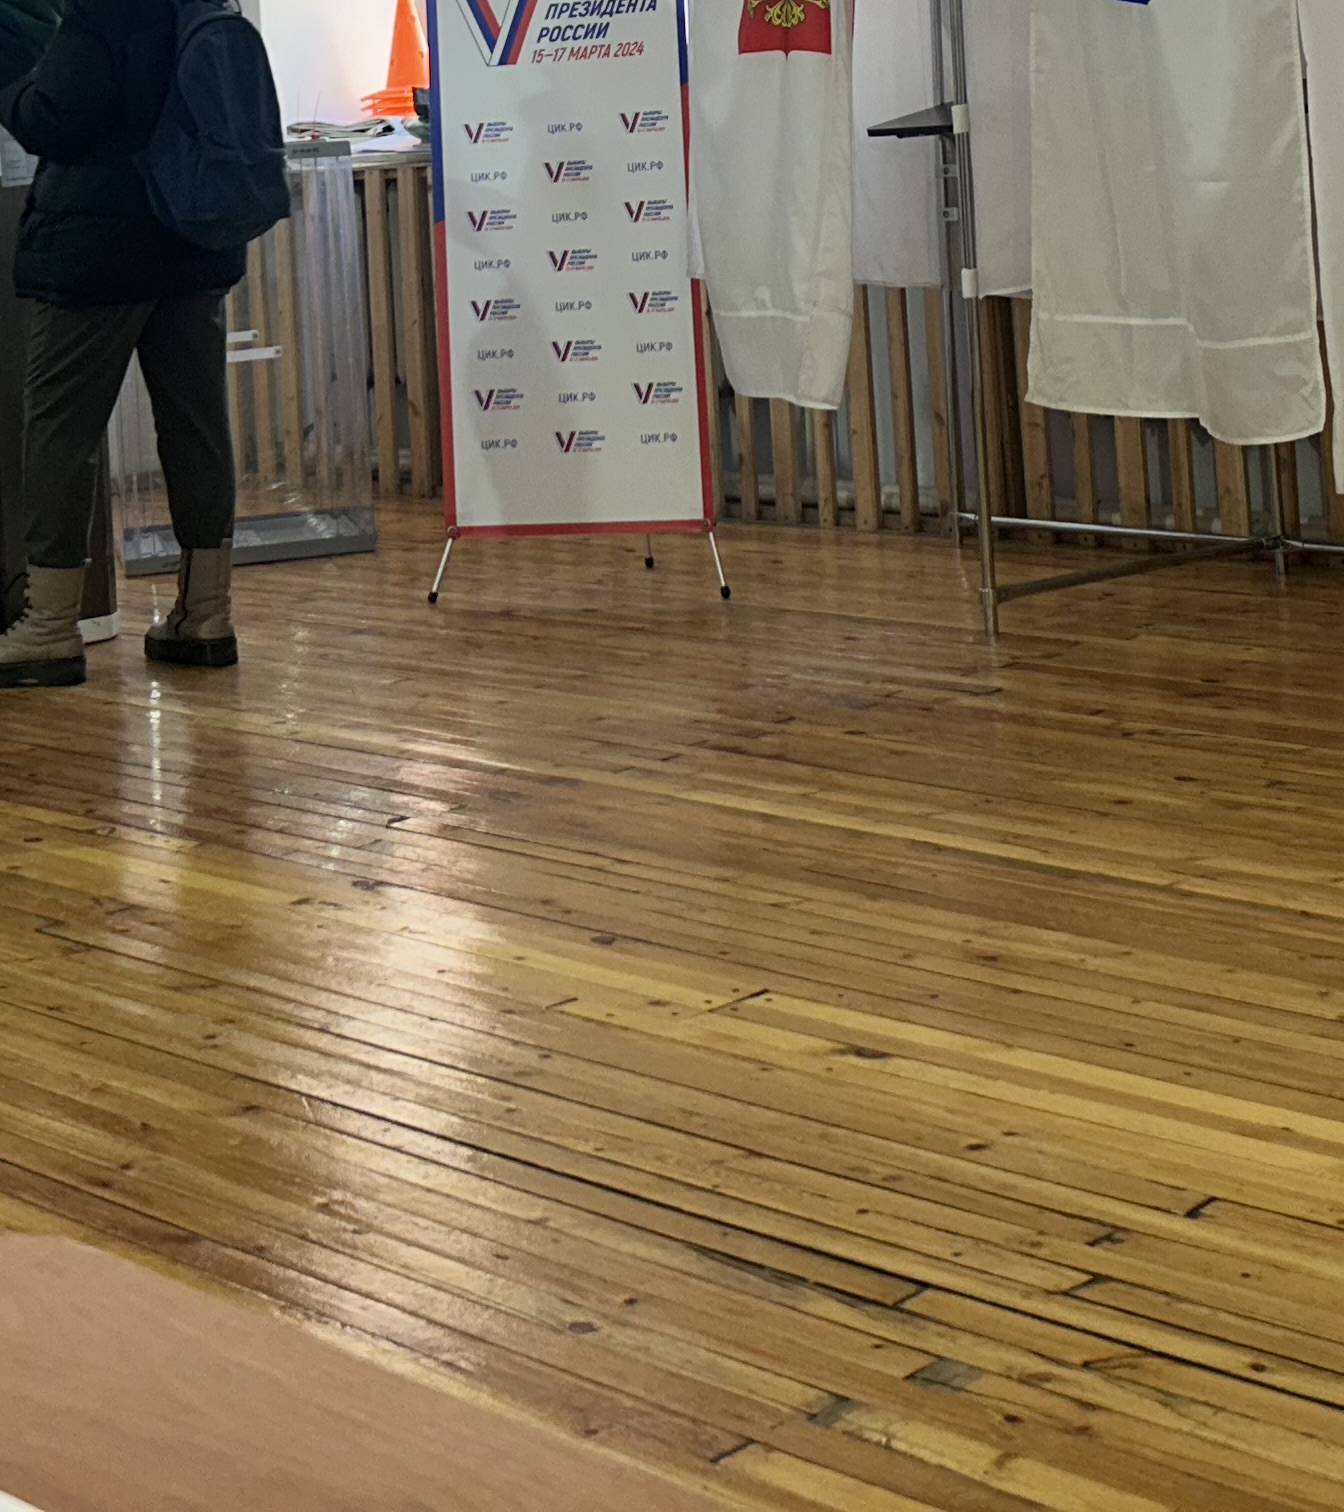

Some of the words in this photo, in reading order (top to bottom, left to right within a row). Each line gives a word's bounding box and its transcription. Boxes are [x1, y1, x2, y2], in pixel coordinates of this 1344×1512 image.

[537, 22, 610, 44] РОССИИ
[567, 44, 611, 61] МАРТА
[613, 41, 645, 58] 2024
[548, 122, 583, 134] ЦИК.РФ
[628, 161, 664, 173] ЦИК.РФ
[471, 171, 508, 183] ЦИК.РФ
[552, 212, 589, 224] ЦИК.РФ
[632, 250, 669, 262] ЦИК.РФ
[474, 259, 512, 270] ЦИК.РФ
[555, 301, 593, 313] ЦИК.РФ
[636, 342, 673, 353] ЦИК.РФ
[478, 349, 515, 361] ЦИК.РФ
[558, 392, 597, 404] ЦИК.РФ
[641, 432, 678, 444] ЦИК.РФ
[481, 439, 518, 451] ЦИК.РФ
